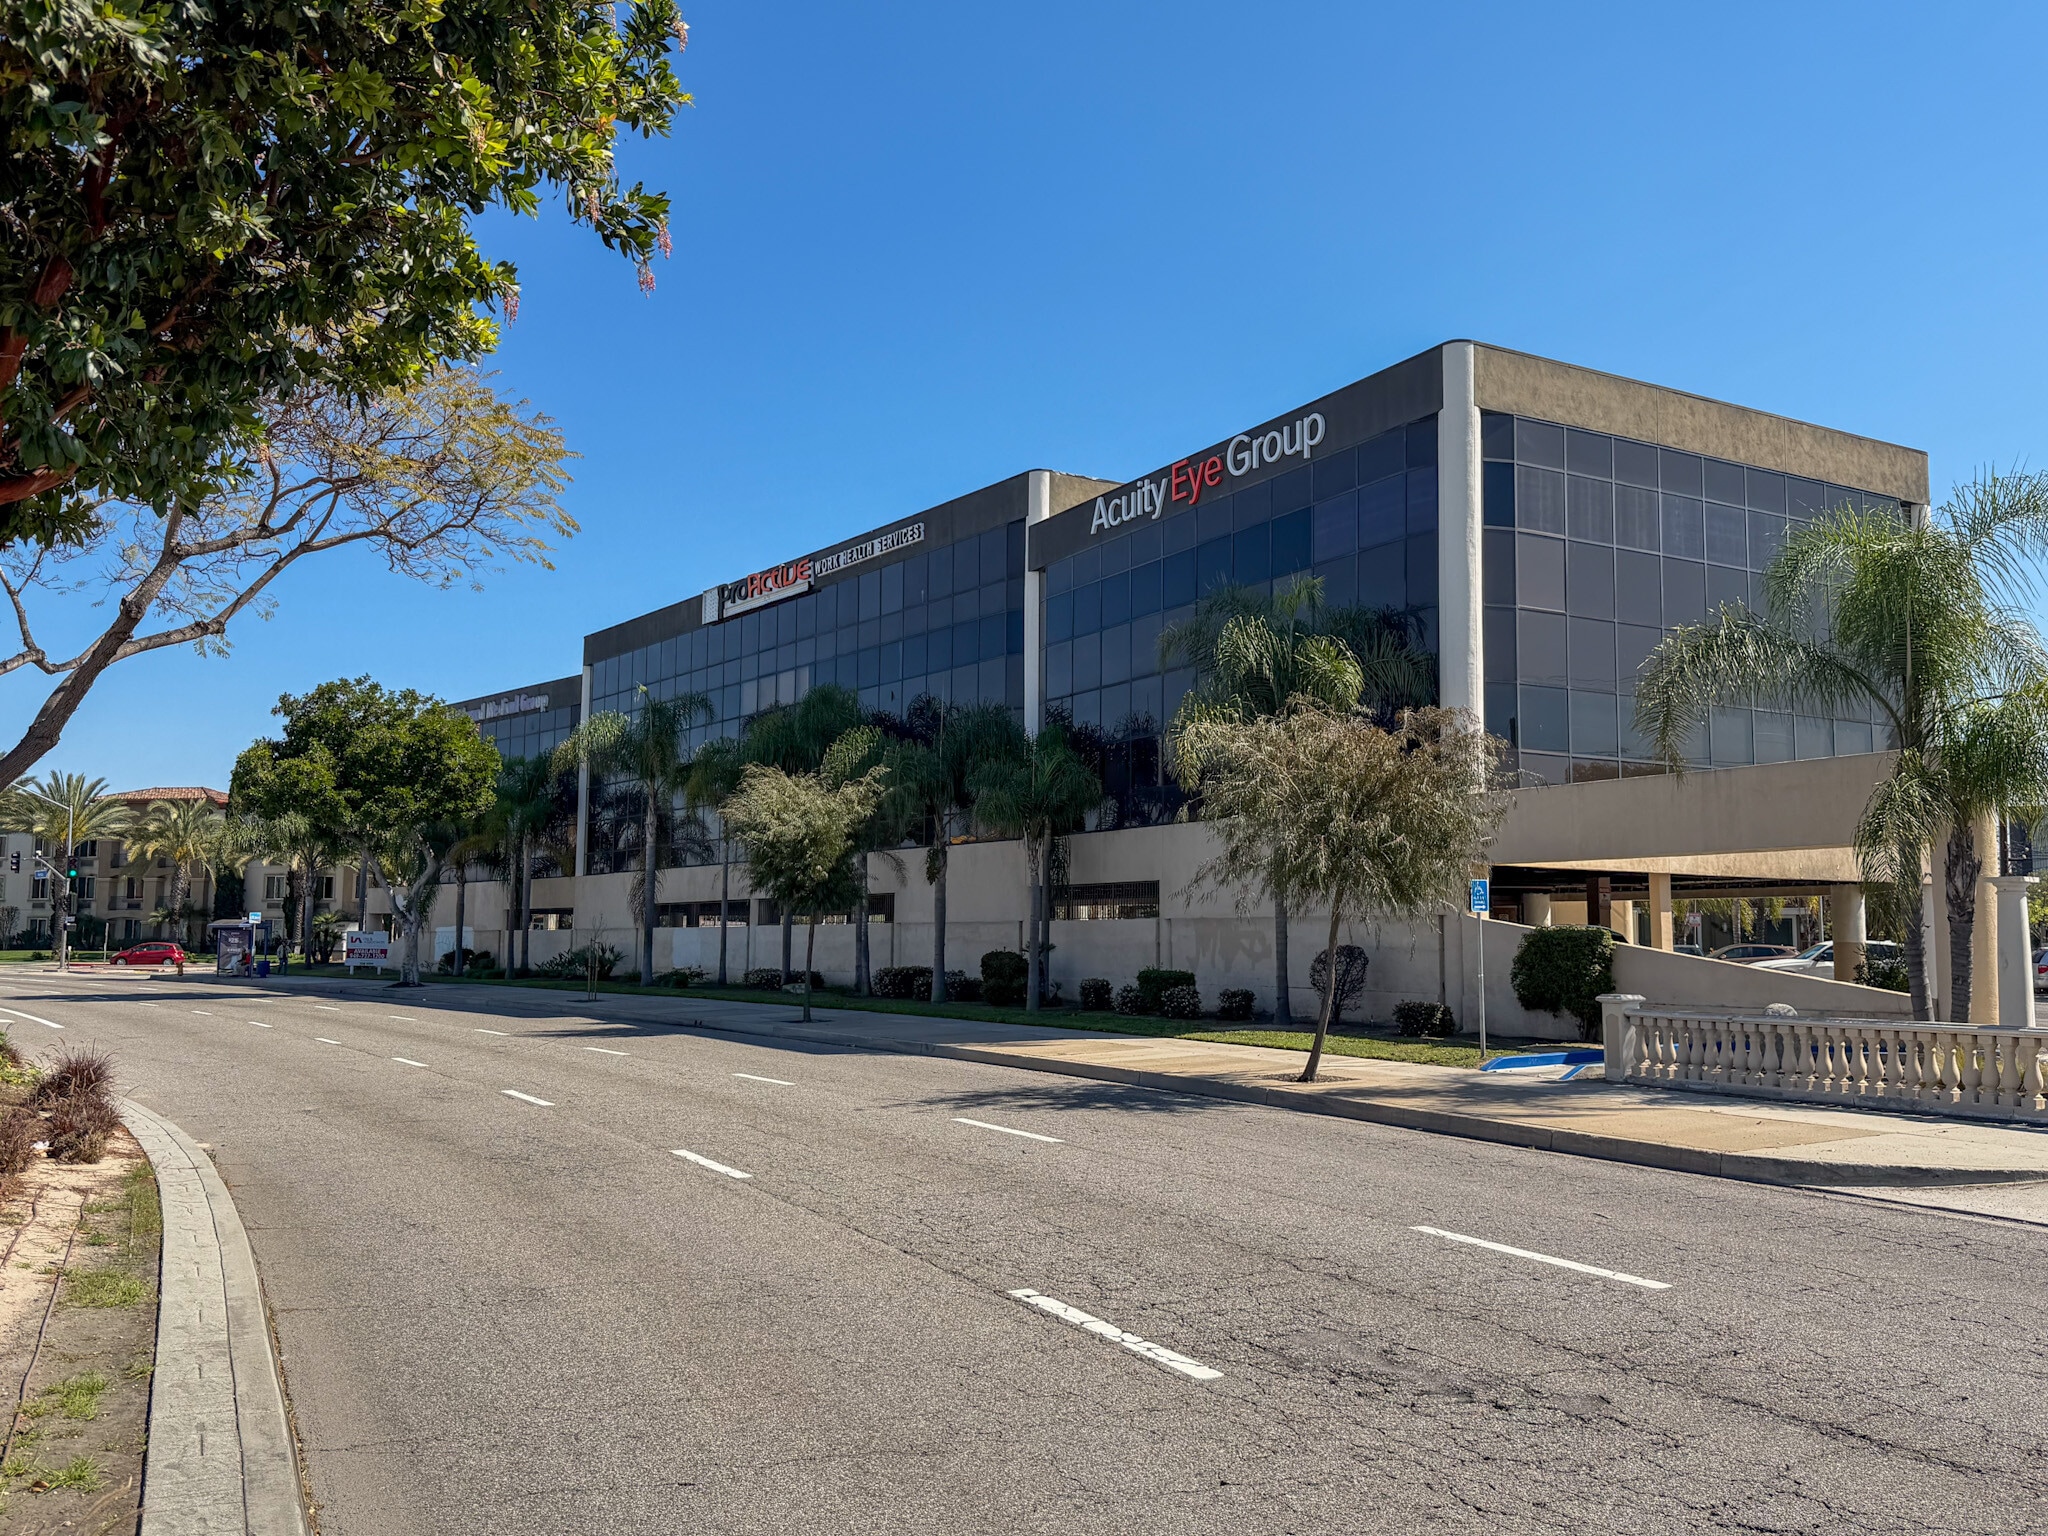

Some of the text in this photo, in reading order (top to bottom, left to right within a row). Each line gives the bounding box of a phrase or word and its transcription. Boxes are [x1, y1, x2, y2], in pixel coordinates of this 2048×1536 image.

[1090, 412, 1326, 535] Acuity Eye Group
[814, 524, 921, 575] WORK HEALTH SERVICES
[520, 693, 549, 712] Group
